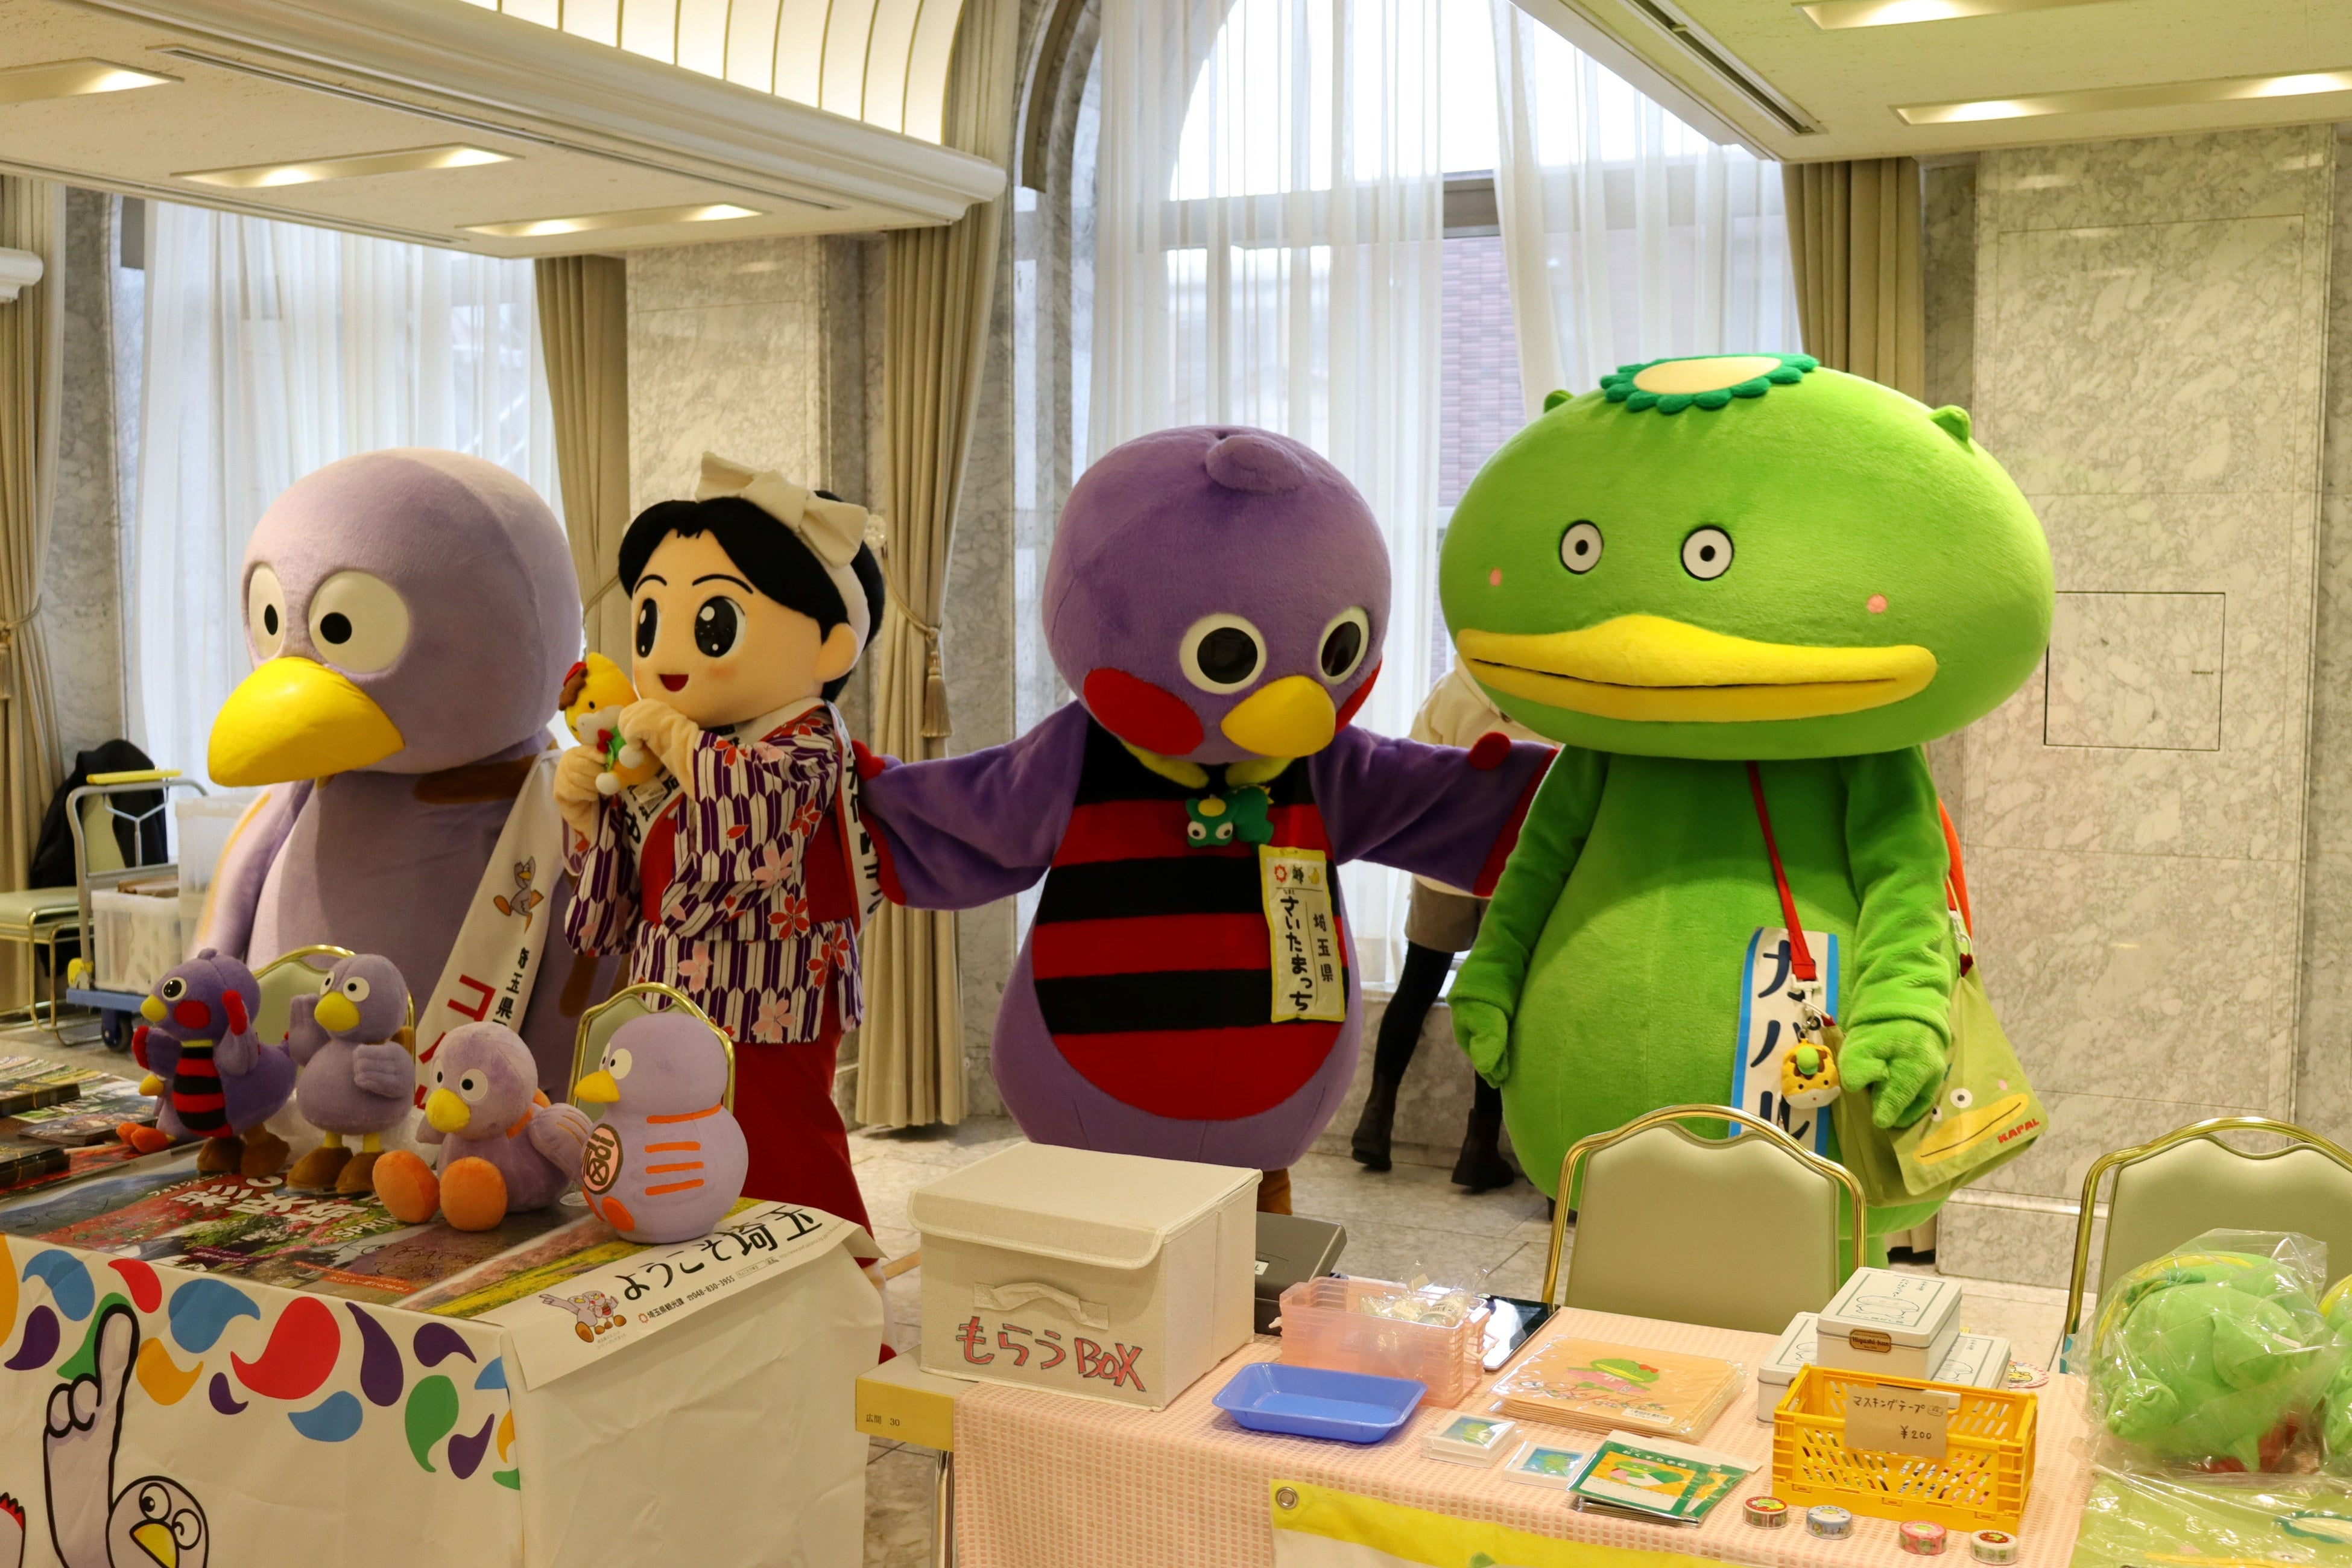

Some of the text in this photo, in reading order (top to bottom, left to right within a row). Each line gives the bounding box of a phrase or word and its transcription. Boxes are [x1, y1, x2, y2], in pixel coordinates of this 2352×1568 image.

[1280, 896, 1314, 1011] さいたまっち
[1312, 914, 1333, 982] 埼玉県
[493, 947, 530, 1026] 埼玉県
[1997, 1118, 2040, 1144] KAPAL
[332, 1215, 398, 1238] SPRIN
[614, 1204, 823, 1300] ようこそ埼玉
[646, 1297, 685, 1319] 埼玉県観光課
[692, 1275, 735, 1300] 048-830-3955
[1851, 1335, 1889, 1347] Higashi-kan
[1853, 1396, 1926, 1414] マスキングテープ
[890, 1417, 900, 1427] 30
[1900, 1425, 1932, 1440] ¥200
[1622, 1450, 1687, 1468] おくすり手帳
